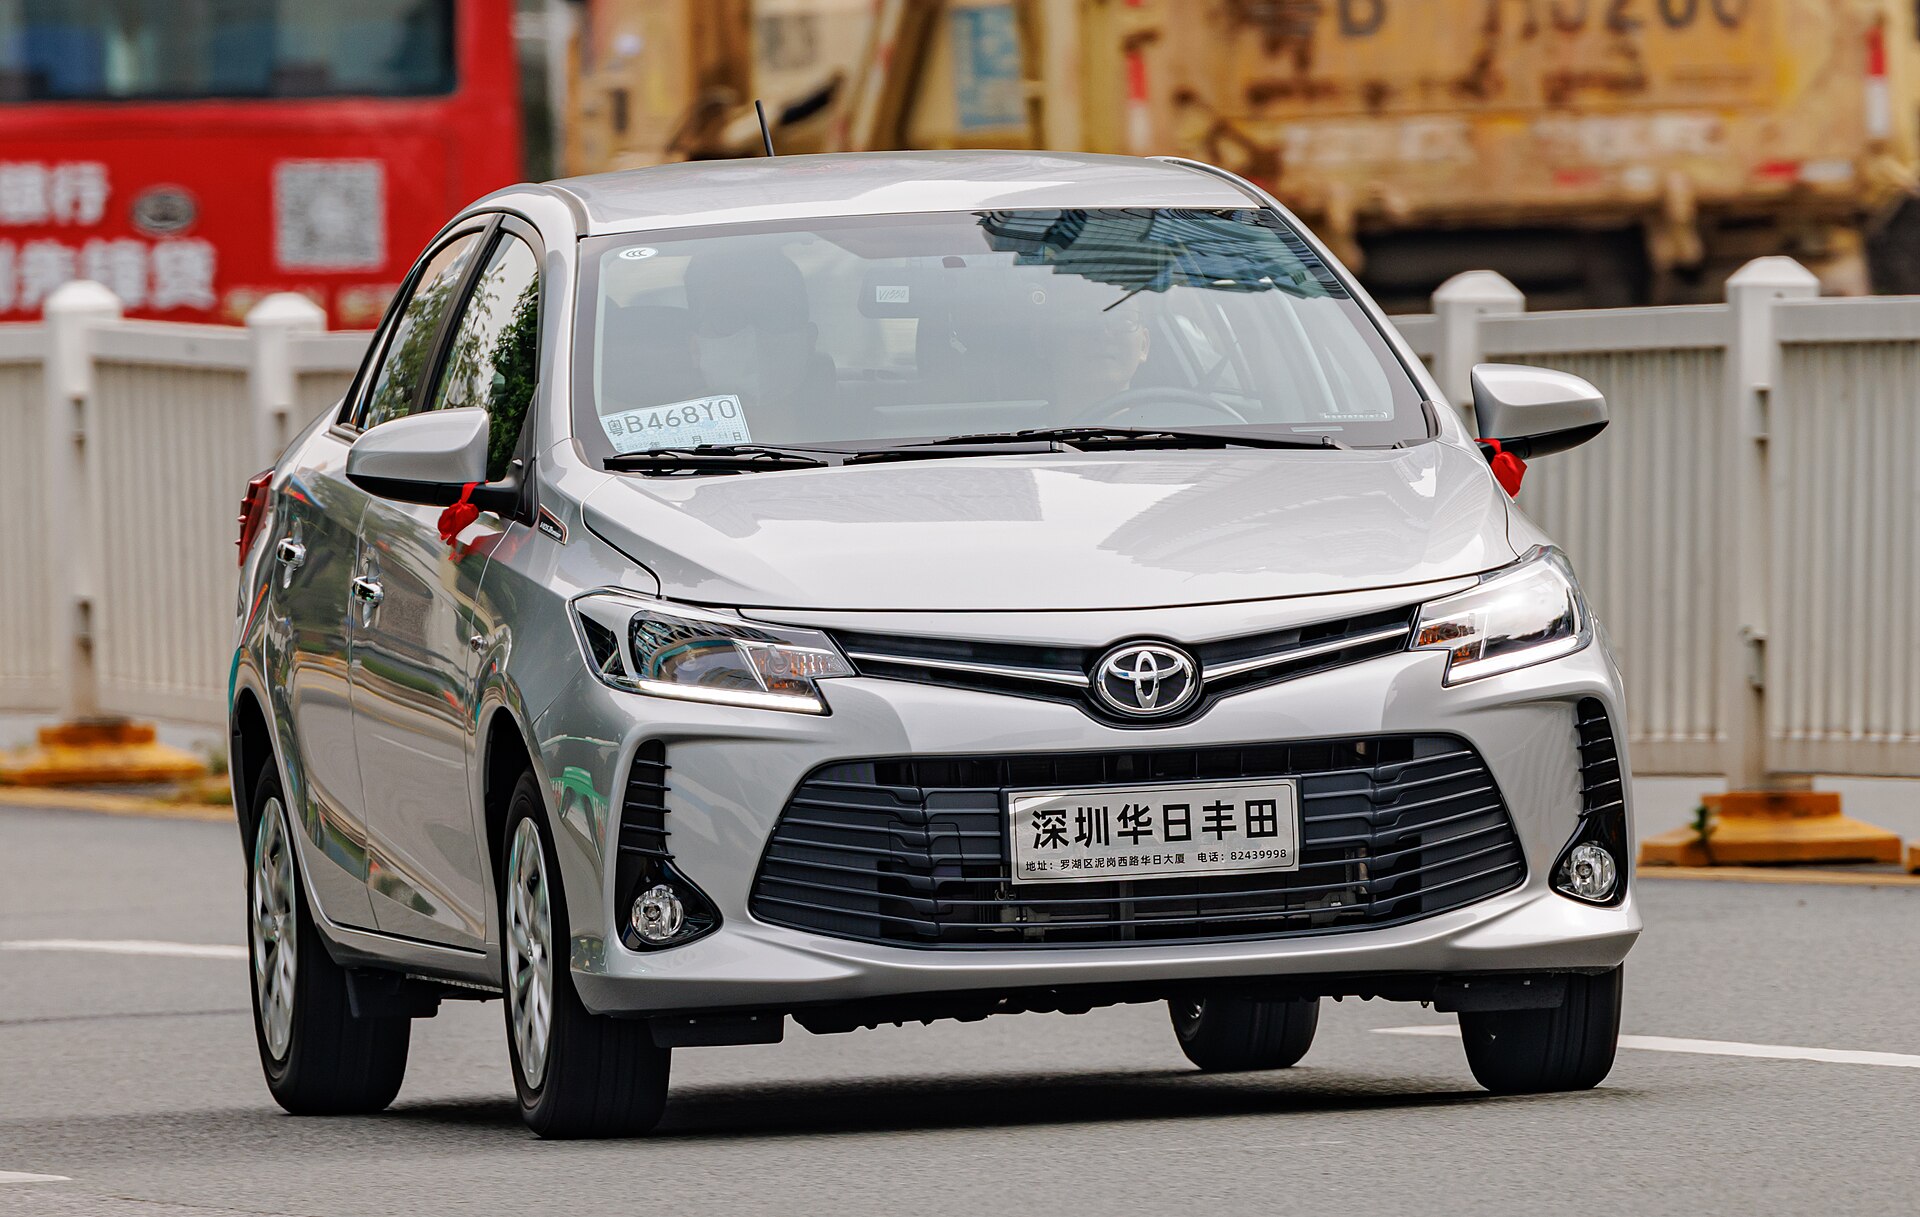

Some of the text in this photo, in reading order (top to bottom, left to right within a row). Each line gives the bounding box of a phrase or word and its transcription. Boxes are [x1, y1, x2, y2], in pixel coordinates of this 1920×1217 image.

[732, 431, 743, 441] 日
[1031, 799, 1278, 850] 深圳华日丰田
